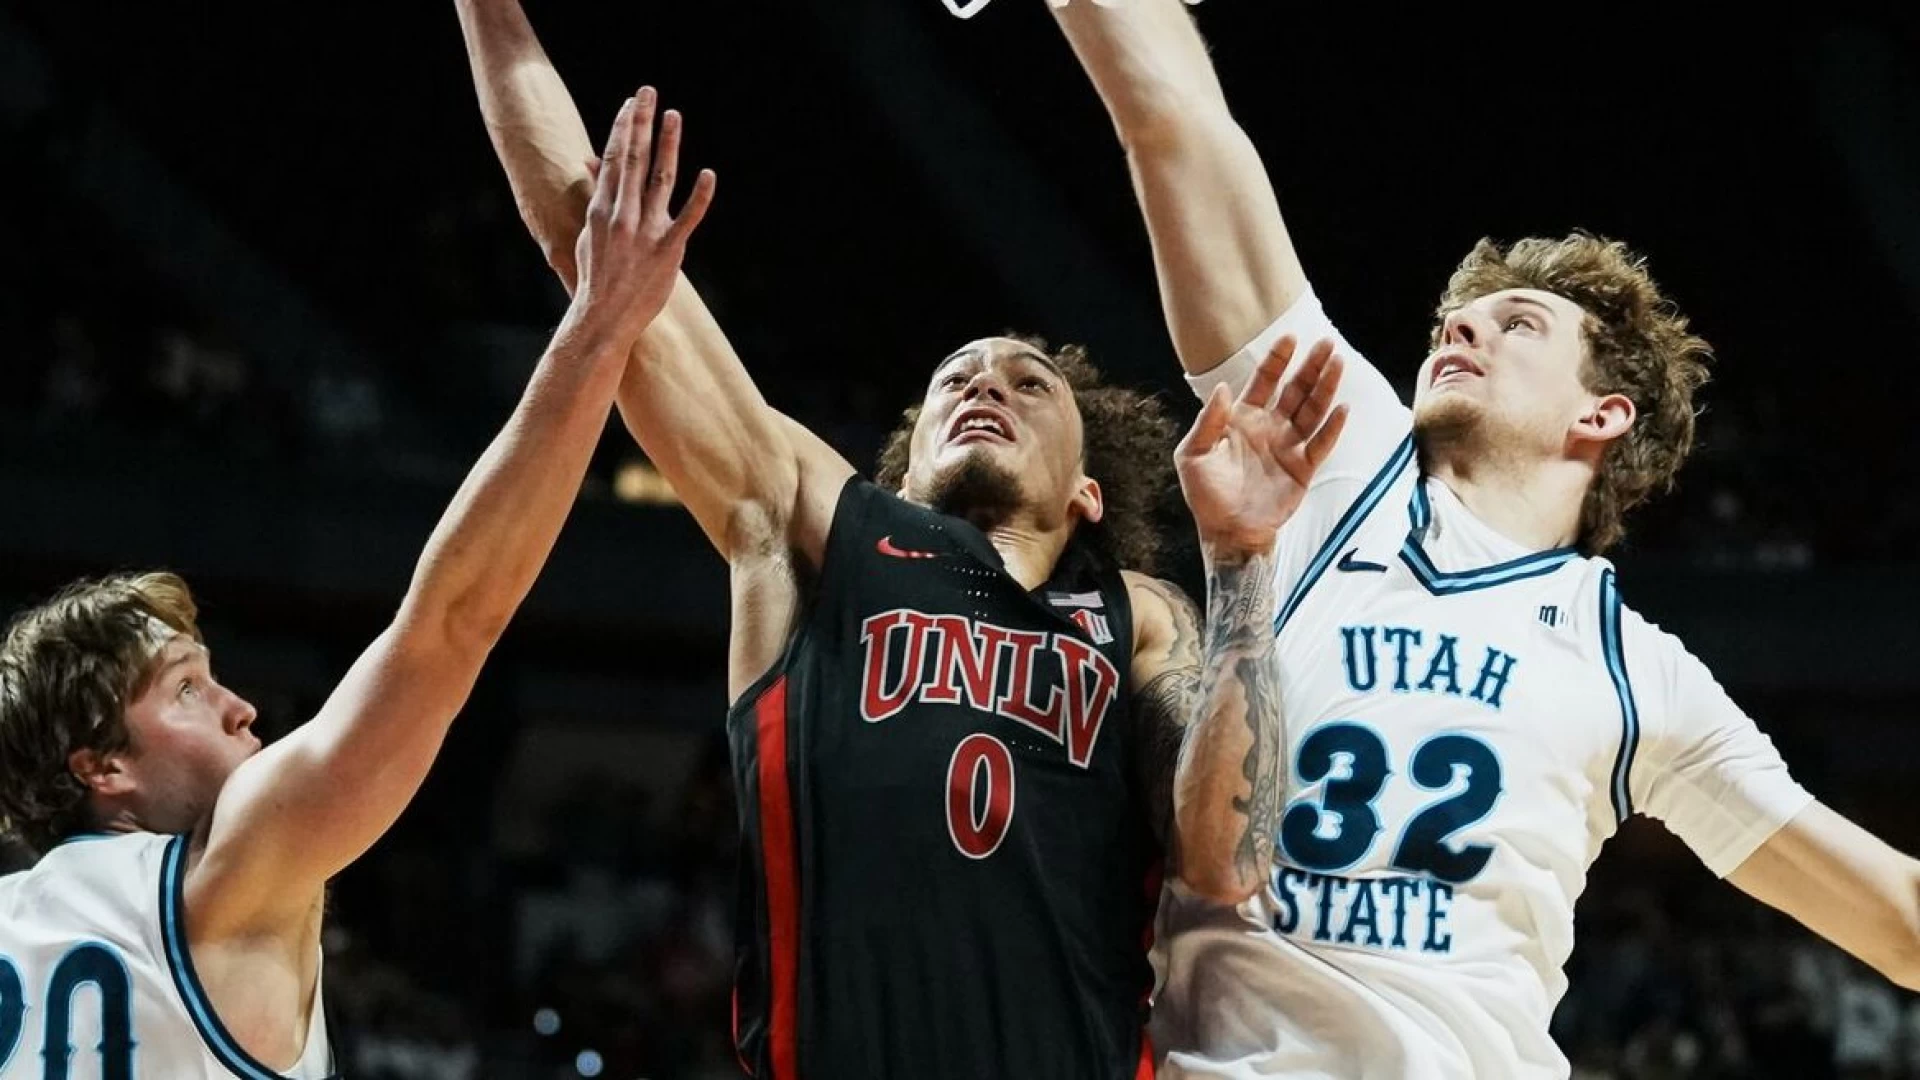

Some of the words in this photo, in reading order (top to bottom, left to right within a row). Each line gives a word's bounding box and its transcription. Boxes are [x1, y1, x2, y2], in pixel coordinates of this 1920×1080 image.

[861, 609, 1119, 768] UNLV
[1340, 625, 1517, 708] UTAH
[946, 733, 1014, 859] 0
[1280, 720, 1504, 884] 32
[1273, 868, 1454, 953] STATE
